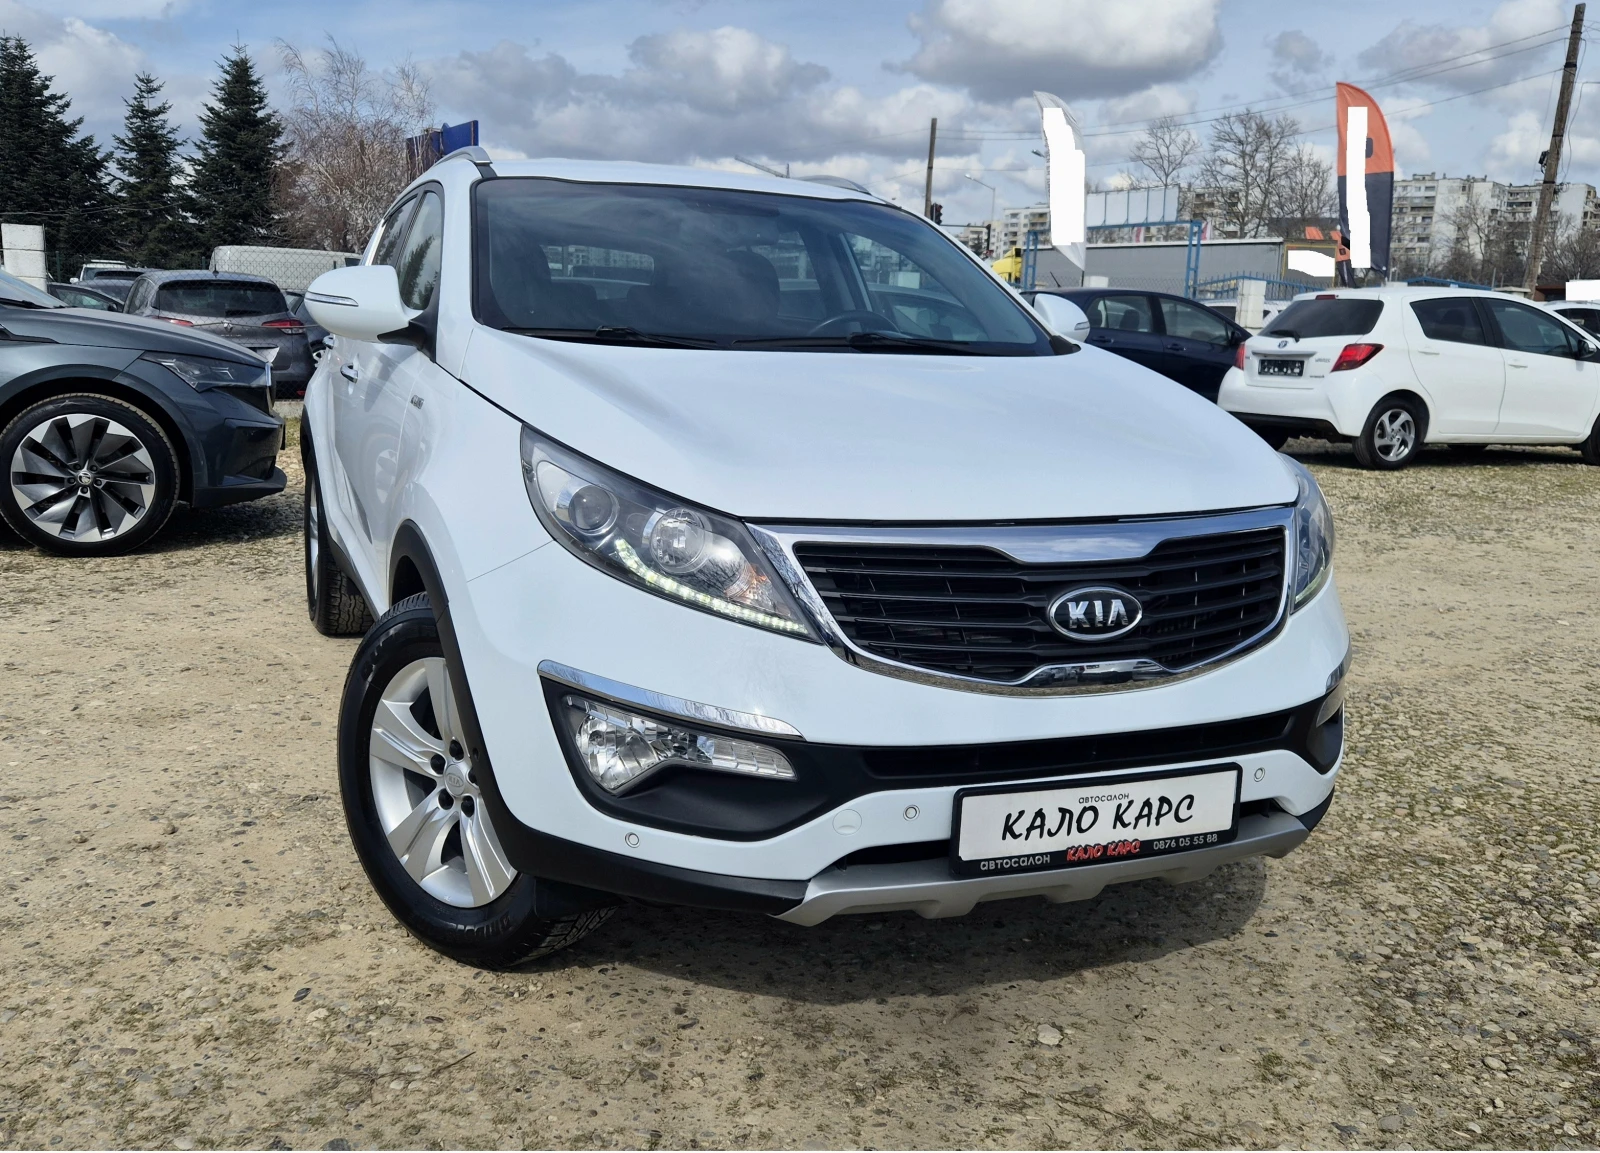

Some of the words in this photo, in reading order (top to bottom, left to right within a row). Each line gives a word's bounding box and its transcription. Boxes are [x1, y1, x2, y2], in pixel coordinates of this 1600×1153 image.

[1066, 599, 1129, 629] KIA
[1078, 792, 1130, 804] автосалон
[1002, 805, 1099, 841] КАЛО
[1112, 794, 1195, 830] КАРС
[980, 854, 1051, 871] автосалон
[1066, 843, 1104, 861] КАЛО
[1107, 839, 1141, 856] КАРС
[1153, 838, 1176, 850] 0876
[1179, 837, 1191, 847] 05
[1193, 835, 1204, 845] 55
[1207, 834, 1218, 843] 88
